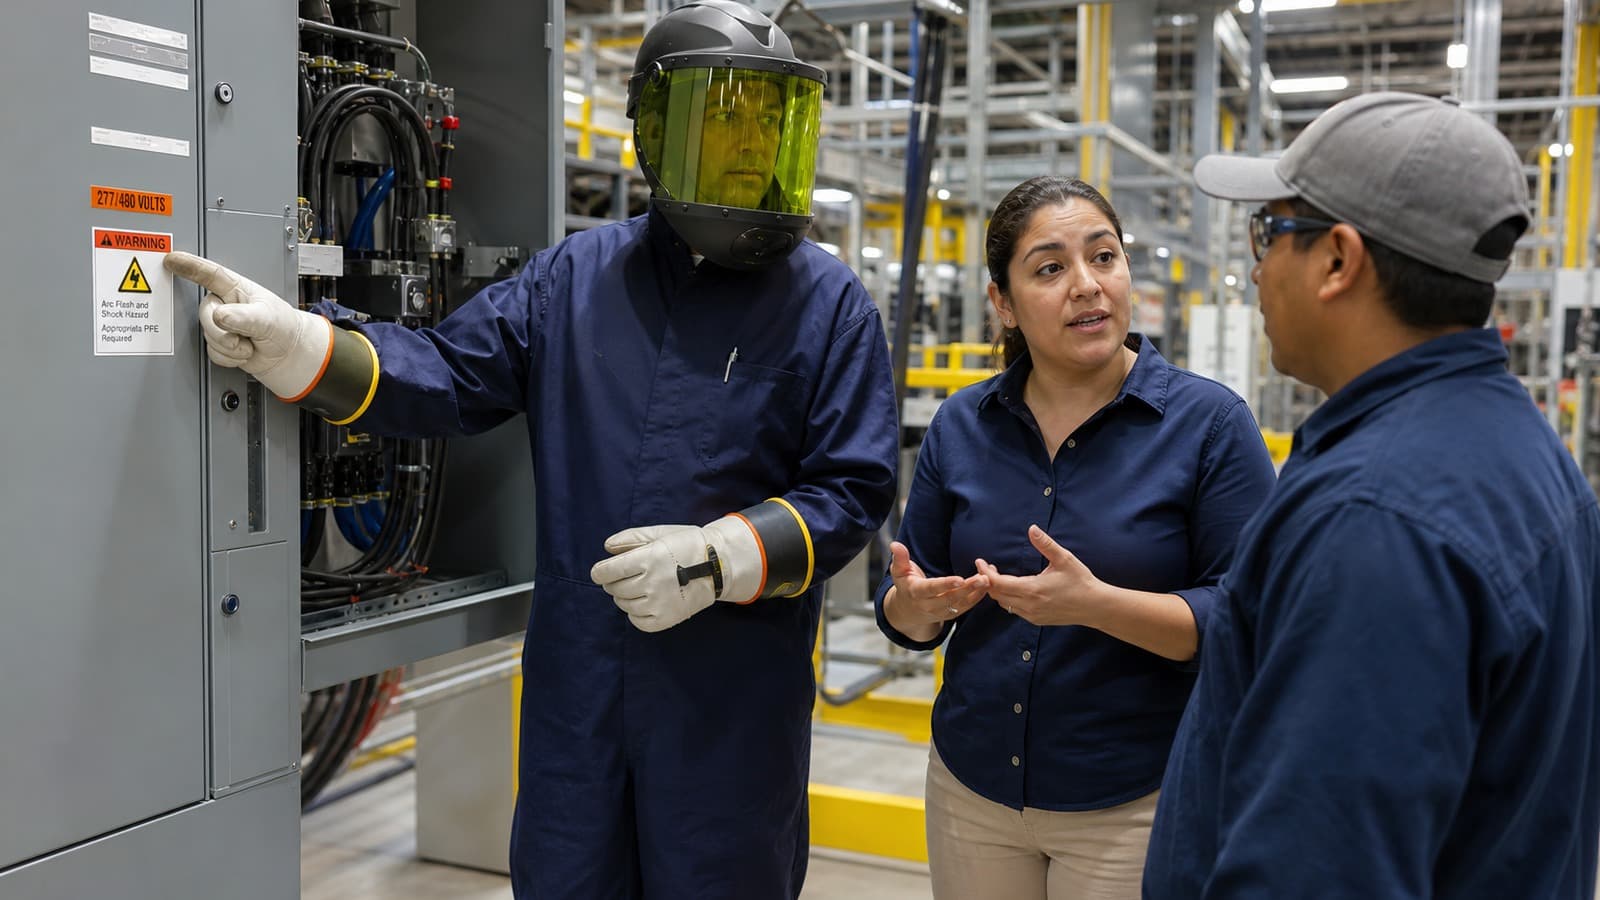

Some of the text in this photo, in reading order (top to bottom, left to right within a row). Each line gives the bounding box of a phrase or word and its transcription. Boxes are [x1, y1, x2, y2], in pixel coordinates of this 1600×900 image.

[97, 190, 166, 212] 277/480 VOLTS
[114, 234, 166, 250] WARNING
[101, 300, 114, 308] Arc
[136, 301, 149, 309] and
[101, 310, 123, 318] Shock
[101, 334, 132, 343] Required
